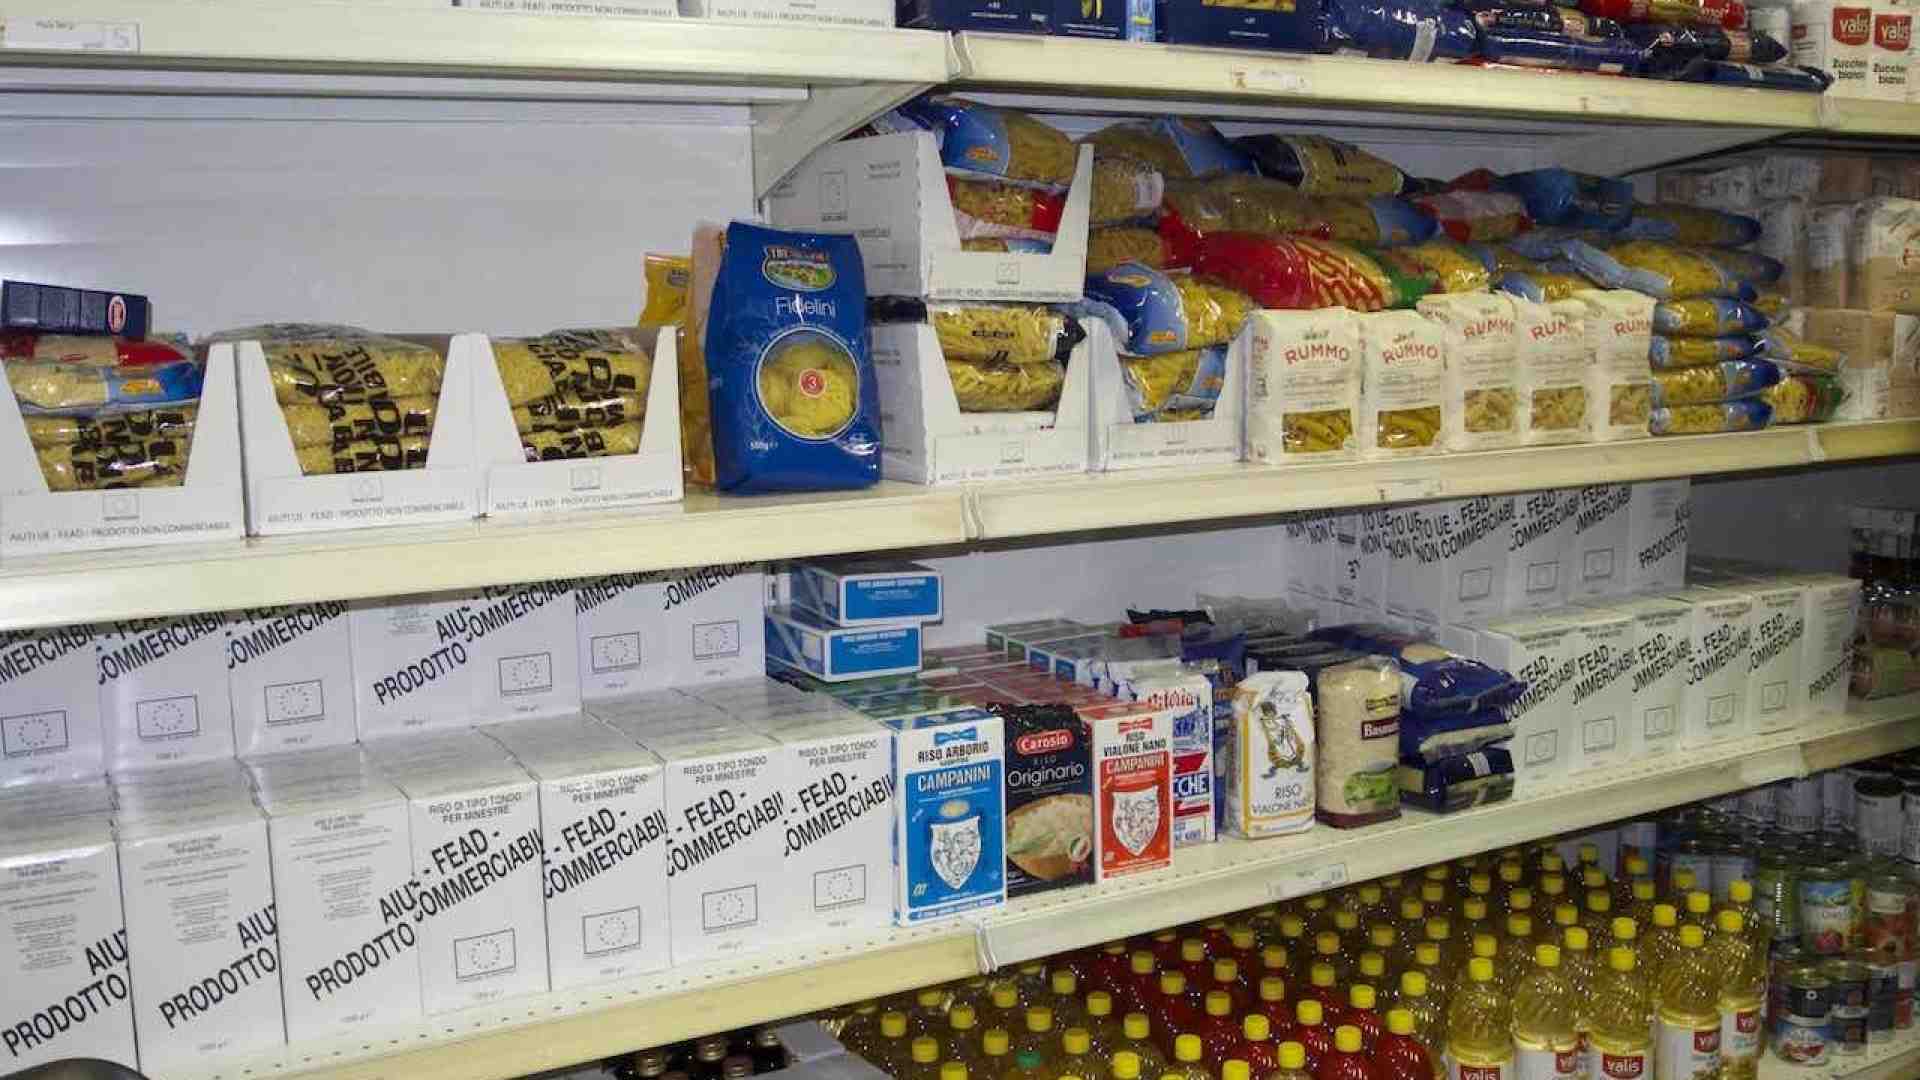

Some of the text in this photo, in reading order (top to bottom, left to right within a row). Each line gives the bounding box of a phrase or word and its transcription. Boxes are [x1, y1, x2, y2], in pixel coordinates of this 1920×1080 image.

[775, 296, 837, 318] Fidelini
[1284, 343, 1351, 365] RUMMO
[1381, 343, 1439, 365] RUMMO
[1508, 492, 1577, 552] OMMERCIABI
[435, 605, 471, 644] AIU
[465, 579, 576, 643] OMMERCIAB
[0, 623, 97, 686] MERCIABI
[98, 611, 225, 685] OMMERCIABI
[227, 599, 349, 670] OMMERCIABI
[1637, 632, 1669, 664] FEAD
[373, 642, 467, 705] PRODOTTO
[1519, 654, 1550, 691] FEAD
[1578, 644, 1610, 675] FEAD
[683, 763, 704, 776] RISO
[717, 759, 737, 771] TIPO
[738, 754, 768, 768] TONDO
[797, 748, 818, 760] RISO
[851, 738, 879, 750] TONDO
[809, 751, 868, 769] PER MINESTRE
[918, 741, 988, 763] RISO ARBORIO
[1106, 753, 1166, 775] CAMPANINI
[1142, 737, 1167, 751] NANO
[695, 767, 758, 785] PER MINESTRE
[798, 770, 848, 813] FEAD
[917, 763, 991, 793] CAMPANINI
[1007, 763, 1085, 788] Originario
[1274, 783, 1302, 800] RISO
[561, 807, 616, 853] FEAD
[684, 788, 736, 832] FEAD
[784, 772, 896, 857] OMMERCIABI
[431, 827, 490, 877] FEAD
[545, 807, 669, 900] OMMERCIABI
[667, 790, 785, 877] OMMERCIABI
[413, 826, 546, 923] OMMERCIABI
[379, 880, 418, 926] AIU
[236, 902, 277, 950] AIU
[83, 927, 128, 977] AIU
[305, 921, 416, 1001] PRODOTTO
[158, 946, 277, 1030] PRODOTTO
[1, 972, 128, 1057] PRODOTTO
[1607, 1053, 1640, 1074] valis
